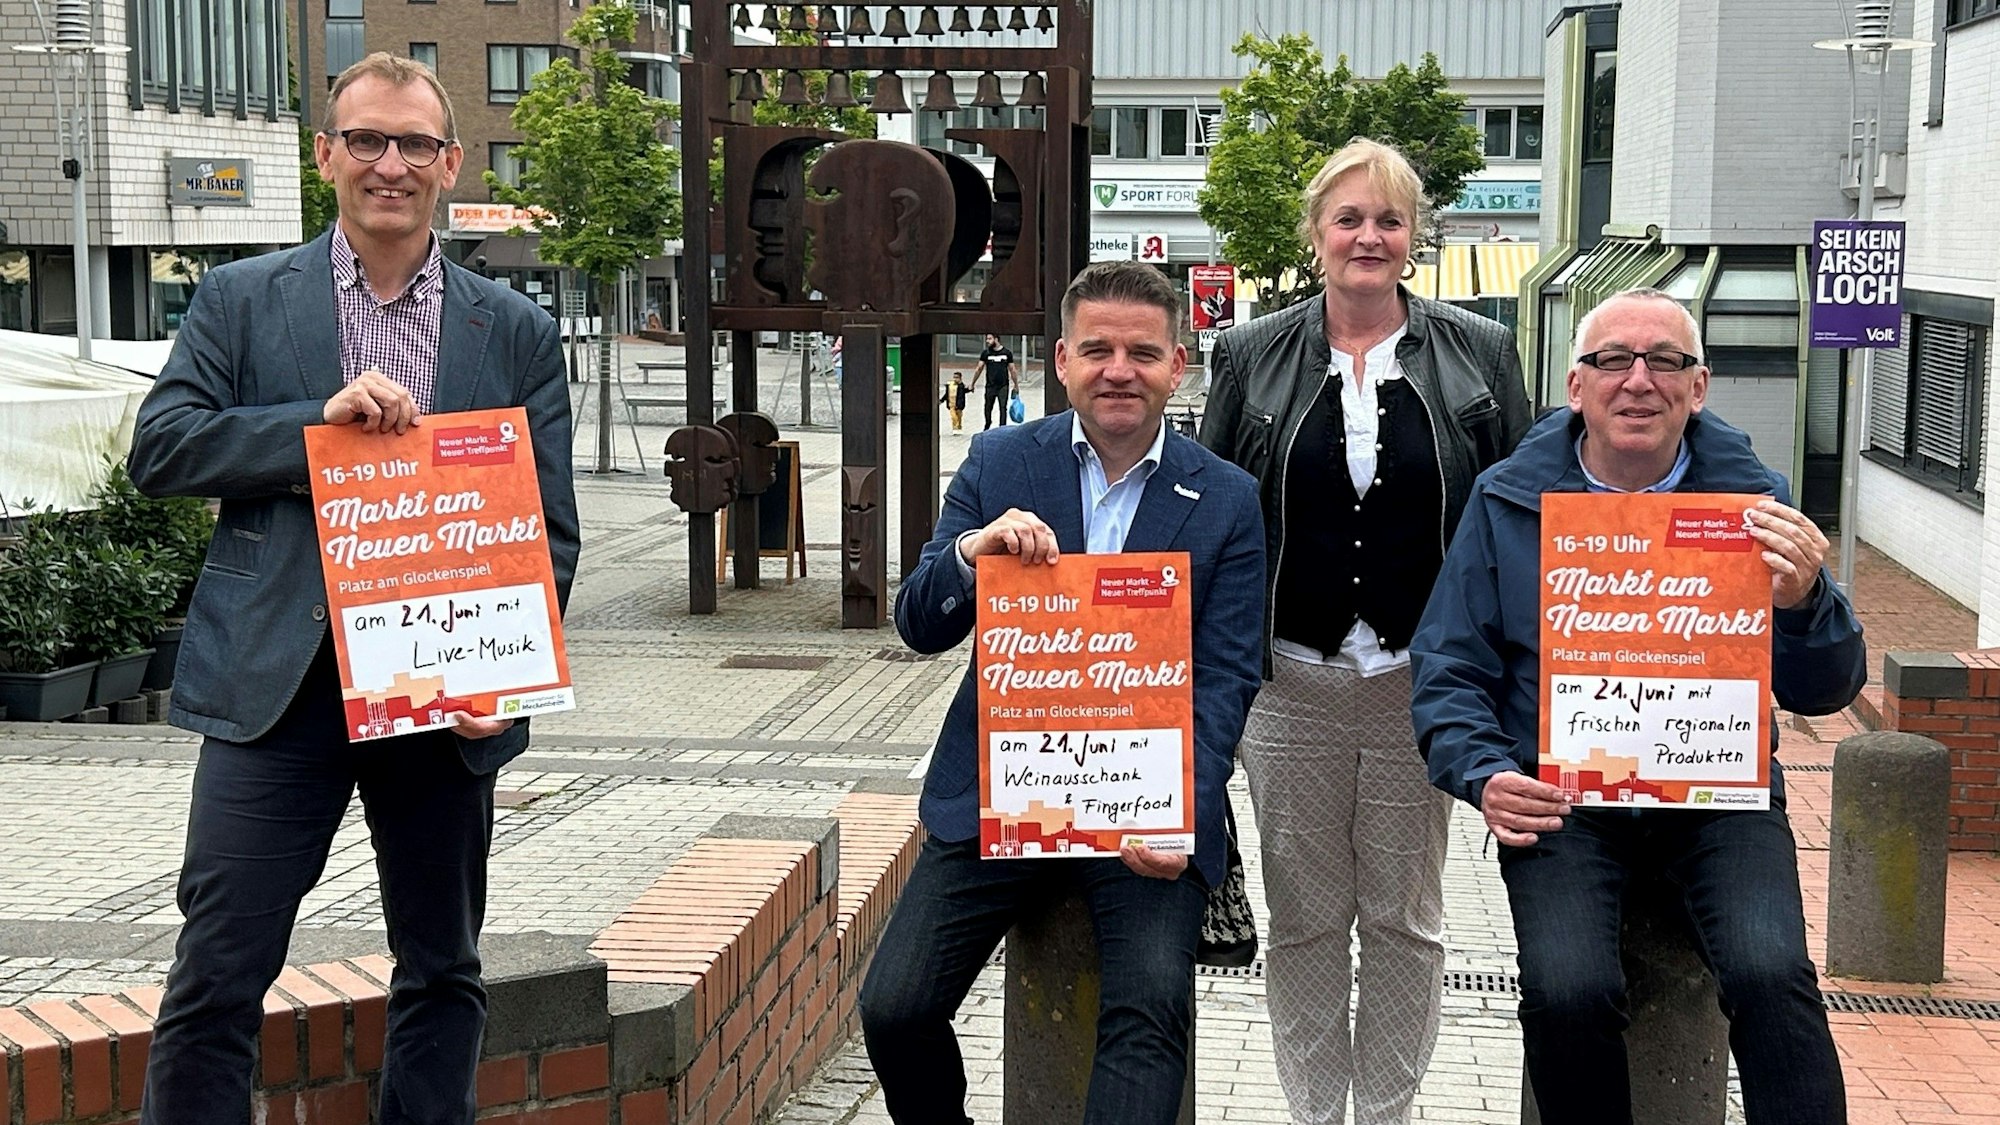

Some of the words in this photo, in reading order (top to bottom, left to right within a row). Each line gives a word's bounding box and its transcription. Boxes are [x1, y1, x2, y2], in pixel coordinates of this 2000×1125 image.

[1121, 190, 1163, 202] SPORT
[488, 208, 507, 219] PC
[1819, 229, 1851, 250] SEI
[1855, 229, 1901, 250] KEIN
[1817, 250, 1901, 275] ARSCH
[1816, 273, 1899, 305] LOCH
[1201, 330, 1219, 340] WC
[1865, 327, 1896, 342] Volt
[438, 438, 464, 447] Neuer
[464, 435, 489, 445] Markt
[440, 448, 465, 458] Neuer
[466, 444, 509, 456] Treffpunkt
[321, 464, 377, 486] 16-19
[380, 459, 420, 480] Uhr
[320, 490, 429, 533] Markt
[433, 489, 487, 516] am
[1674, 519, 1702, 528] Neuer
[1702, 519, 1729, 529] Markt
[1674, 529, 1702, 539] Neuer
[1702, 529, 1748, 541] Treffpunkt
[325, 530, 435, 570] Neuen
[437, 513, 543, 555] Markt
[1552, 535, 1608, 553] 16-19
[1612, 534, 1652, 553] Uhr
[338, 579, 375, 595] Platz
[376, 576, 399, 590] am
[402, 561, 493, 587] Glockenspiel
[1100, 578, 1125, 587] Neuer
[1125, 577, 1150, 586] Markt
[1545, 566, 1655, 602] Markt
[1657, 574, 1714, 598] am
[988, 595, 1040, 614] 16-19
[1044, 593, 1081, 613] Uhr
[1100, 588, 1125, 597] Neuer
[1126, 587, 1168, 598] Treffpunkt
[354, 615, 386, 631] am
[400, 603, 437, 628] 21.
[440, 599, 482, 634] Juni
[496, 597, 521, 613] mit
[1545, 603, 1653, 638] Neuen
[1655, 605, 1768, 642] Markt
[413, 633, 537, 670] Live-Musik
[982, 626, 1084, 662] Markt
[1087, 631, 1138, 653] am
[1551, 647, 1587, 662] Platz
[1589, 649, 1612, 663] am
[1614, 648, 1706, 666] Glockenspiel
[982, 662, 1085, 697] Neuen
[1087, 659, 1188, 696] Markt
[1556, 681, 1583, 695] am
[1594, 678, 1628, 701] 21.
[1630, 681, 1676, 714] Juni
[1687, 684, 1712, 700] mit
[989, 705, 1022, 719] Platz
[1025, 707, 1046, 719] am
[1049, 703, 1135, 719] Glockenspiel
[1568, 711, 1641, 736] frischen
[1664, 714, 1751, 744] regionalen
[1000, 739, 1027, 753] am
[1039, 732, 1073, 754] 21.
[1074, 732, 1116, 768] Juni
[1129, 736, 1149, 750] mit
[1654, 743, 1744, 765] Produkten
[1004, 763, 1142, 788] Weinausschank
[1081, 793, 1173, 824] Fingerfood
